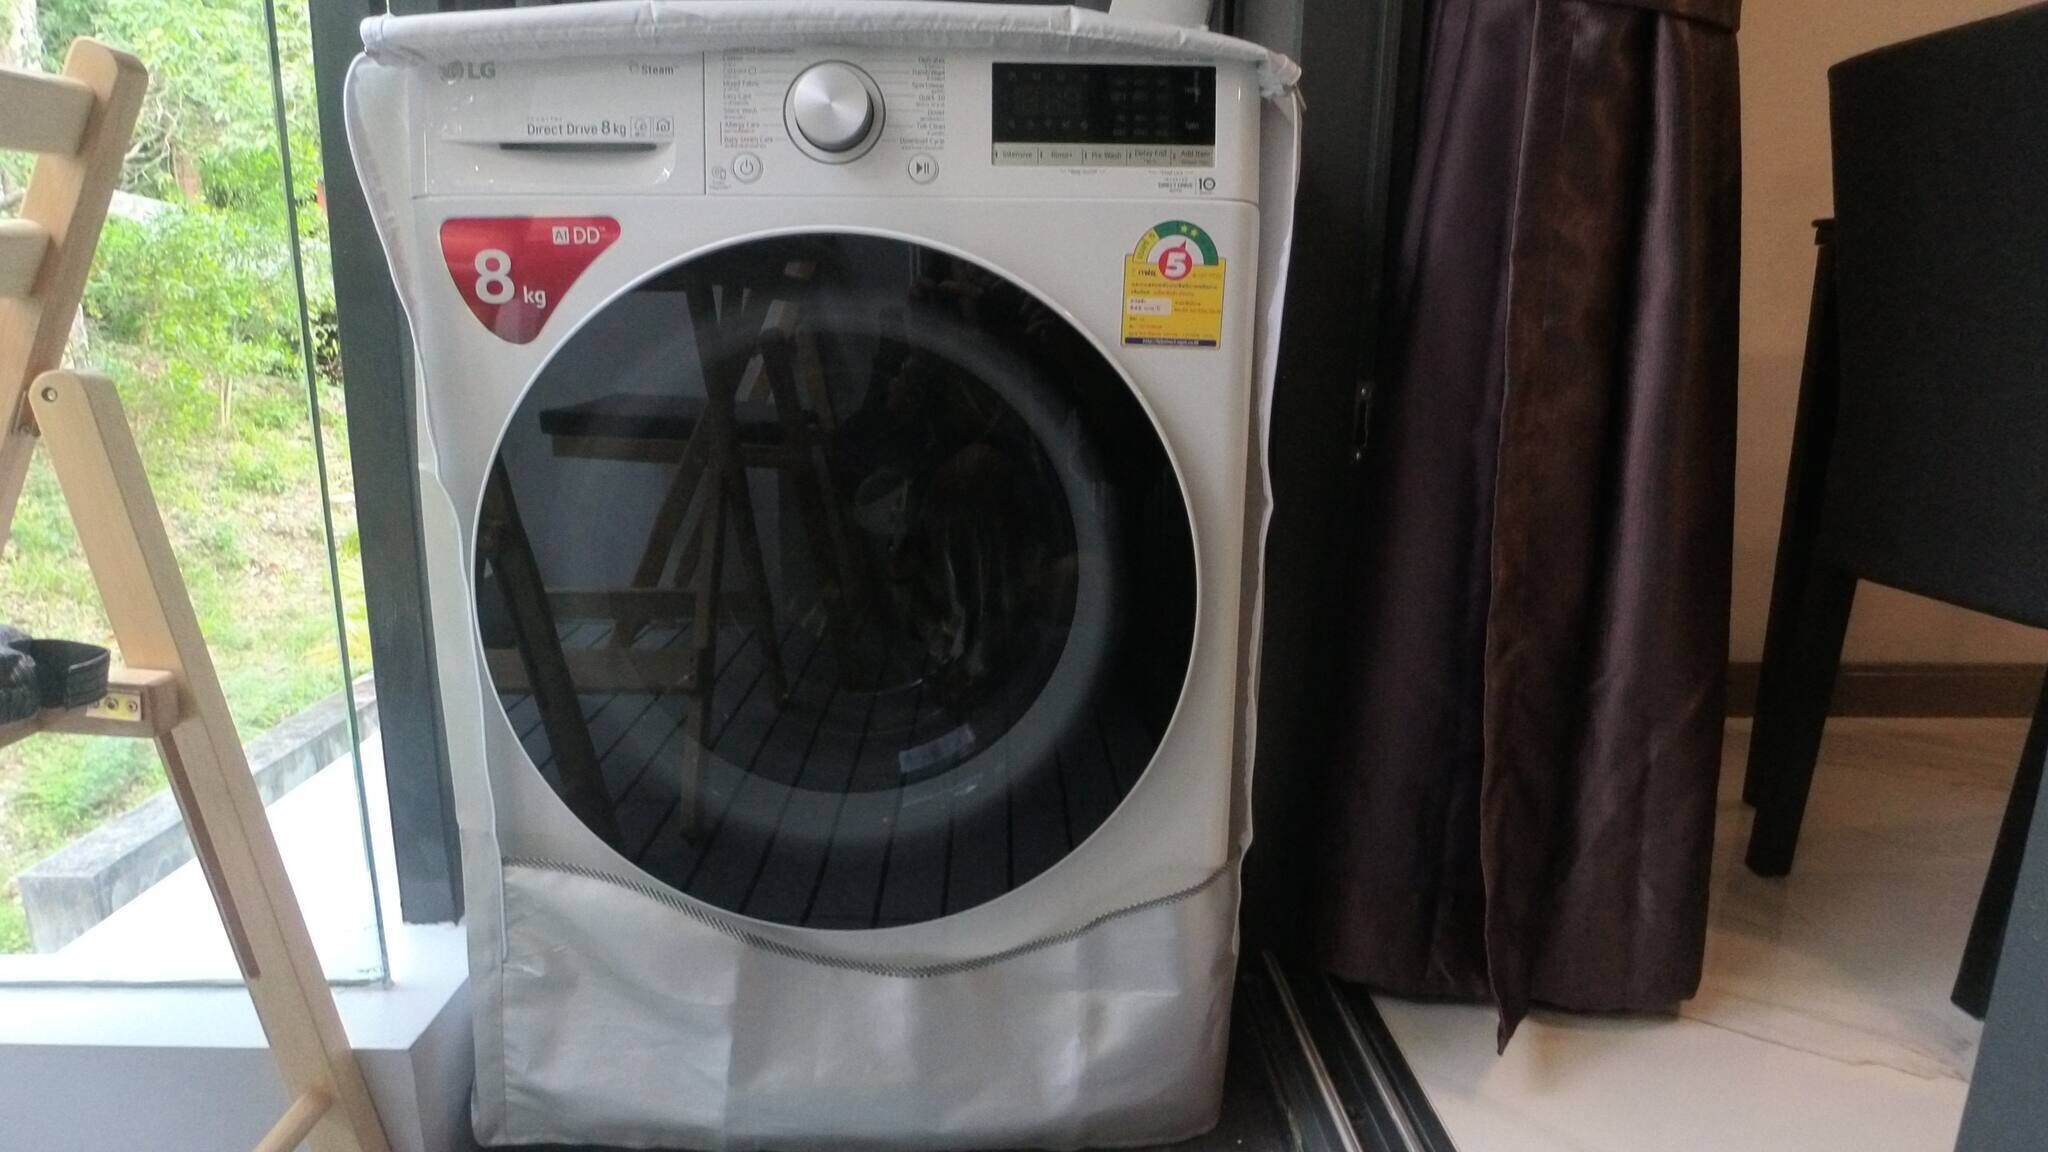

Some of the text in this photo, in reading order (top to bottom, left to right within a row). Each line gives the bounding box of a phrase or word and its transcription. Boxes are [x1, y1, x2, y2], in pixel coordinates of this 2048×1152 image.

[467, 61, 496, 80] LG
[641, 64, 675, 75] Steam
[527, 120, 626, 138] Direct Drive 8 kg
[554, 229, 569, 242] AI
[1164, 251, 1188, 277] 5
[474, 248, 516, 305] 8
[523, 285, 547, 309] kg
